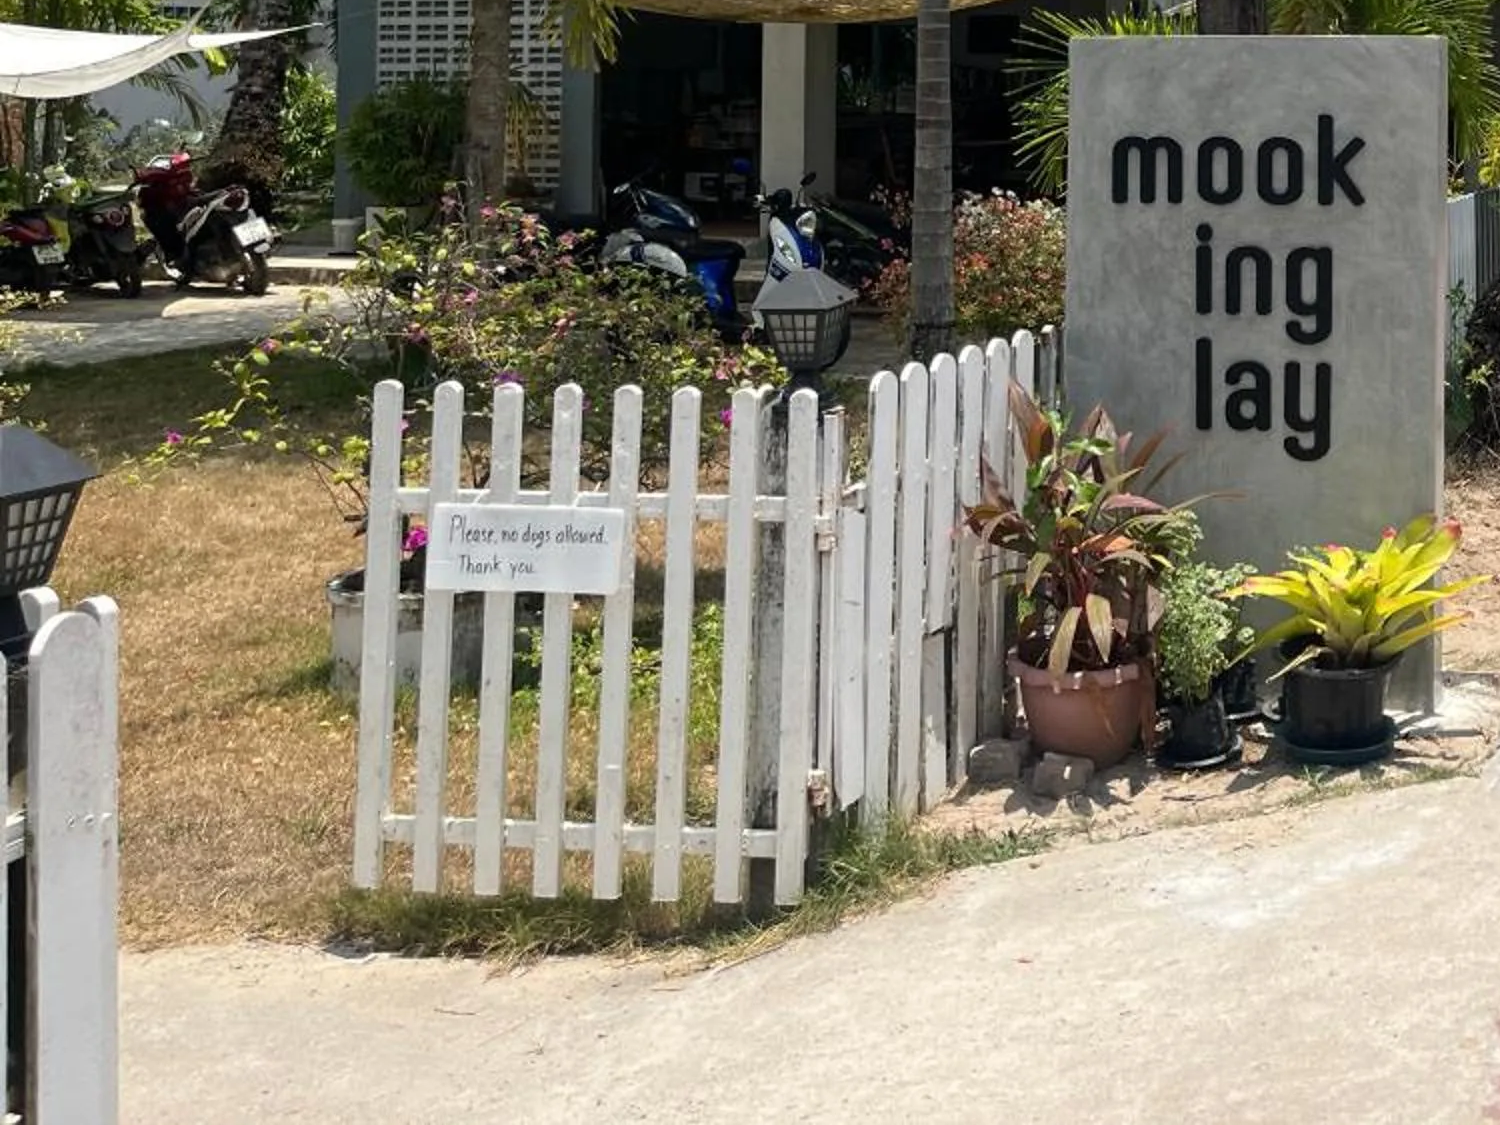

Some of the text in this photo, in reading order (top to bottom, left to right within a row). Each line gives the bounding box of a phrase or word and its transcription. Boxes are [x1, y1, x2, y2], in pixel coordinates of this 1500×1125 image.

[1111, 113, 1366, 207] mook
[1195, 222, 1333, 346] ing
[1195, 336, 1333, 462] lay
[459, 554, 503, 575] Thank
[501, 529, 519, 543] no
[522, 523, 551, 549] dogs
